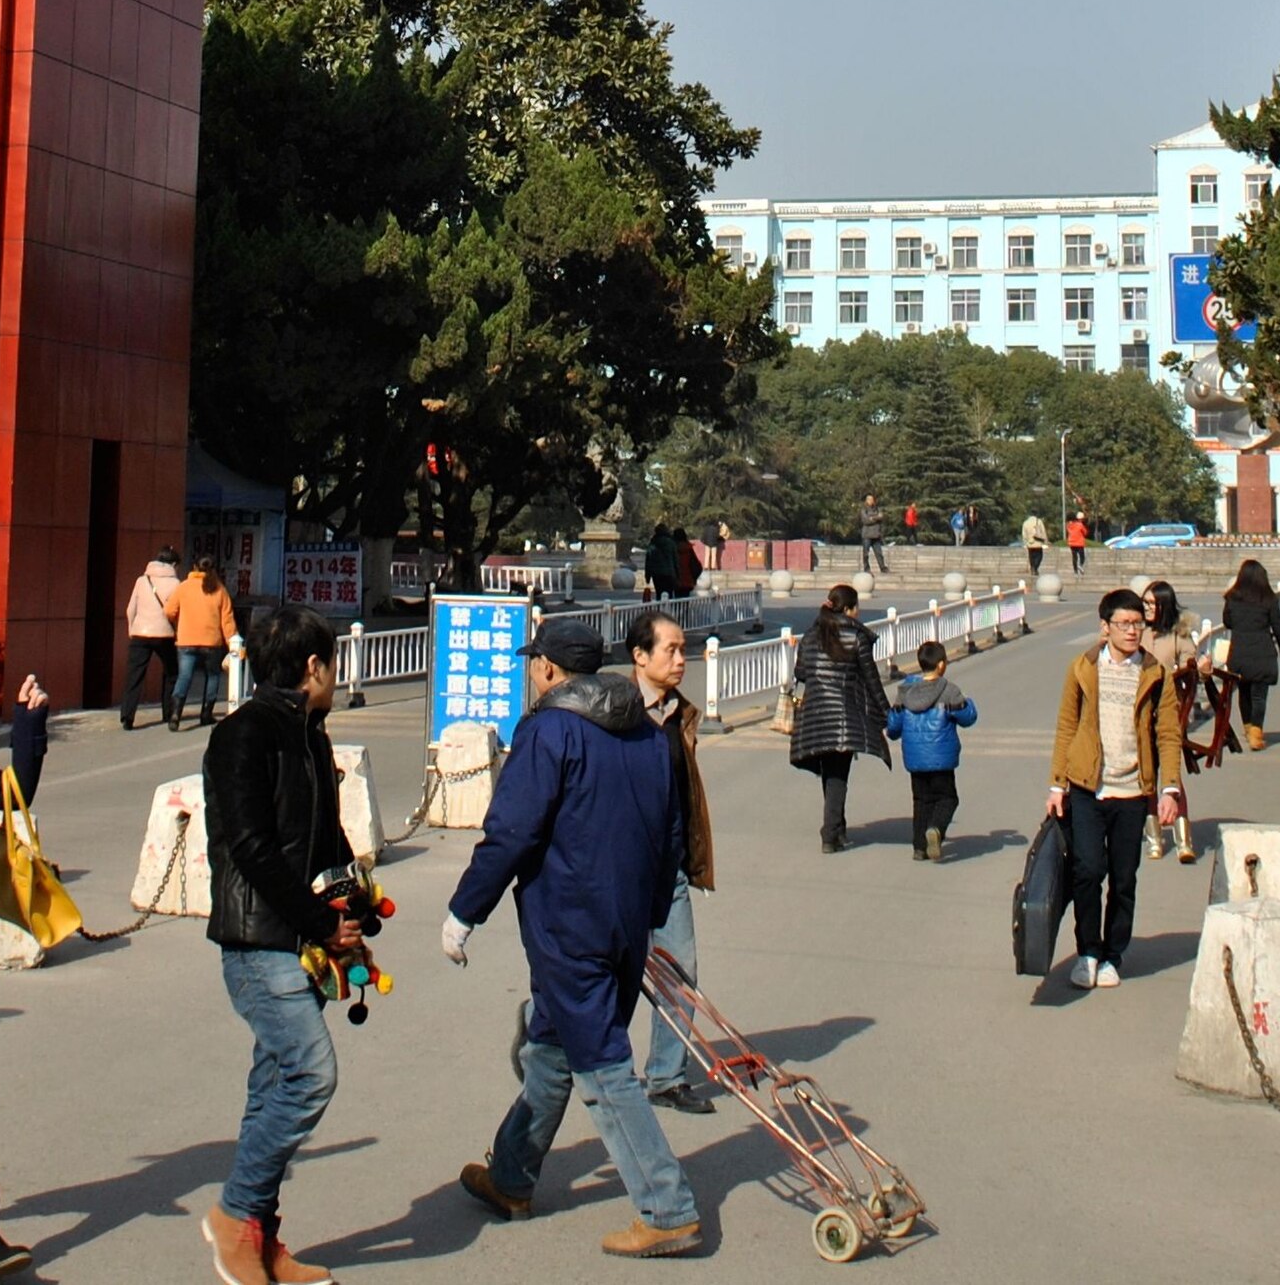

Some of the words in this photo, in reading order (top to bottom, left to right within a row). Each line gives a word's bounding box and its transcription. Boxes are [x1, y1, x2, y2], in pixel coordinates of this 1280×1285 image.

[450, 607, 512, 629] 禁止
[449, 630, 512, 651] 出租车
[448, 652, 511, 674] 货车
[447, 675, 511, 696] 面包车
[446, 697, 510, 719] 摩托车
